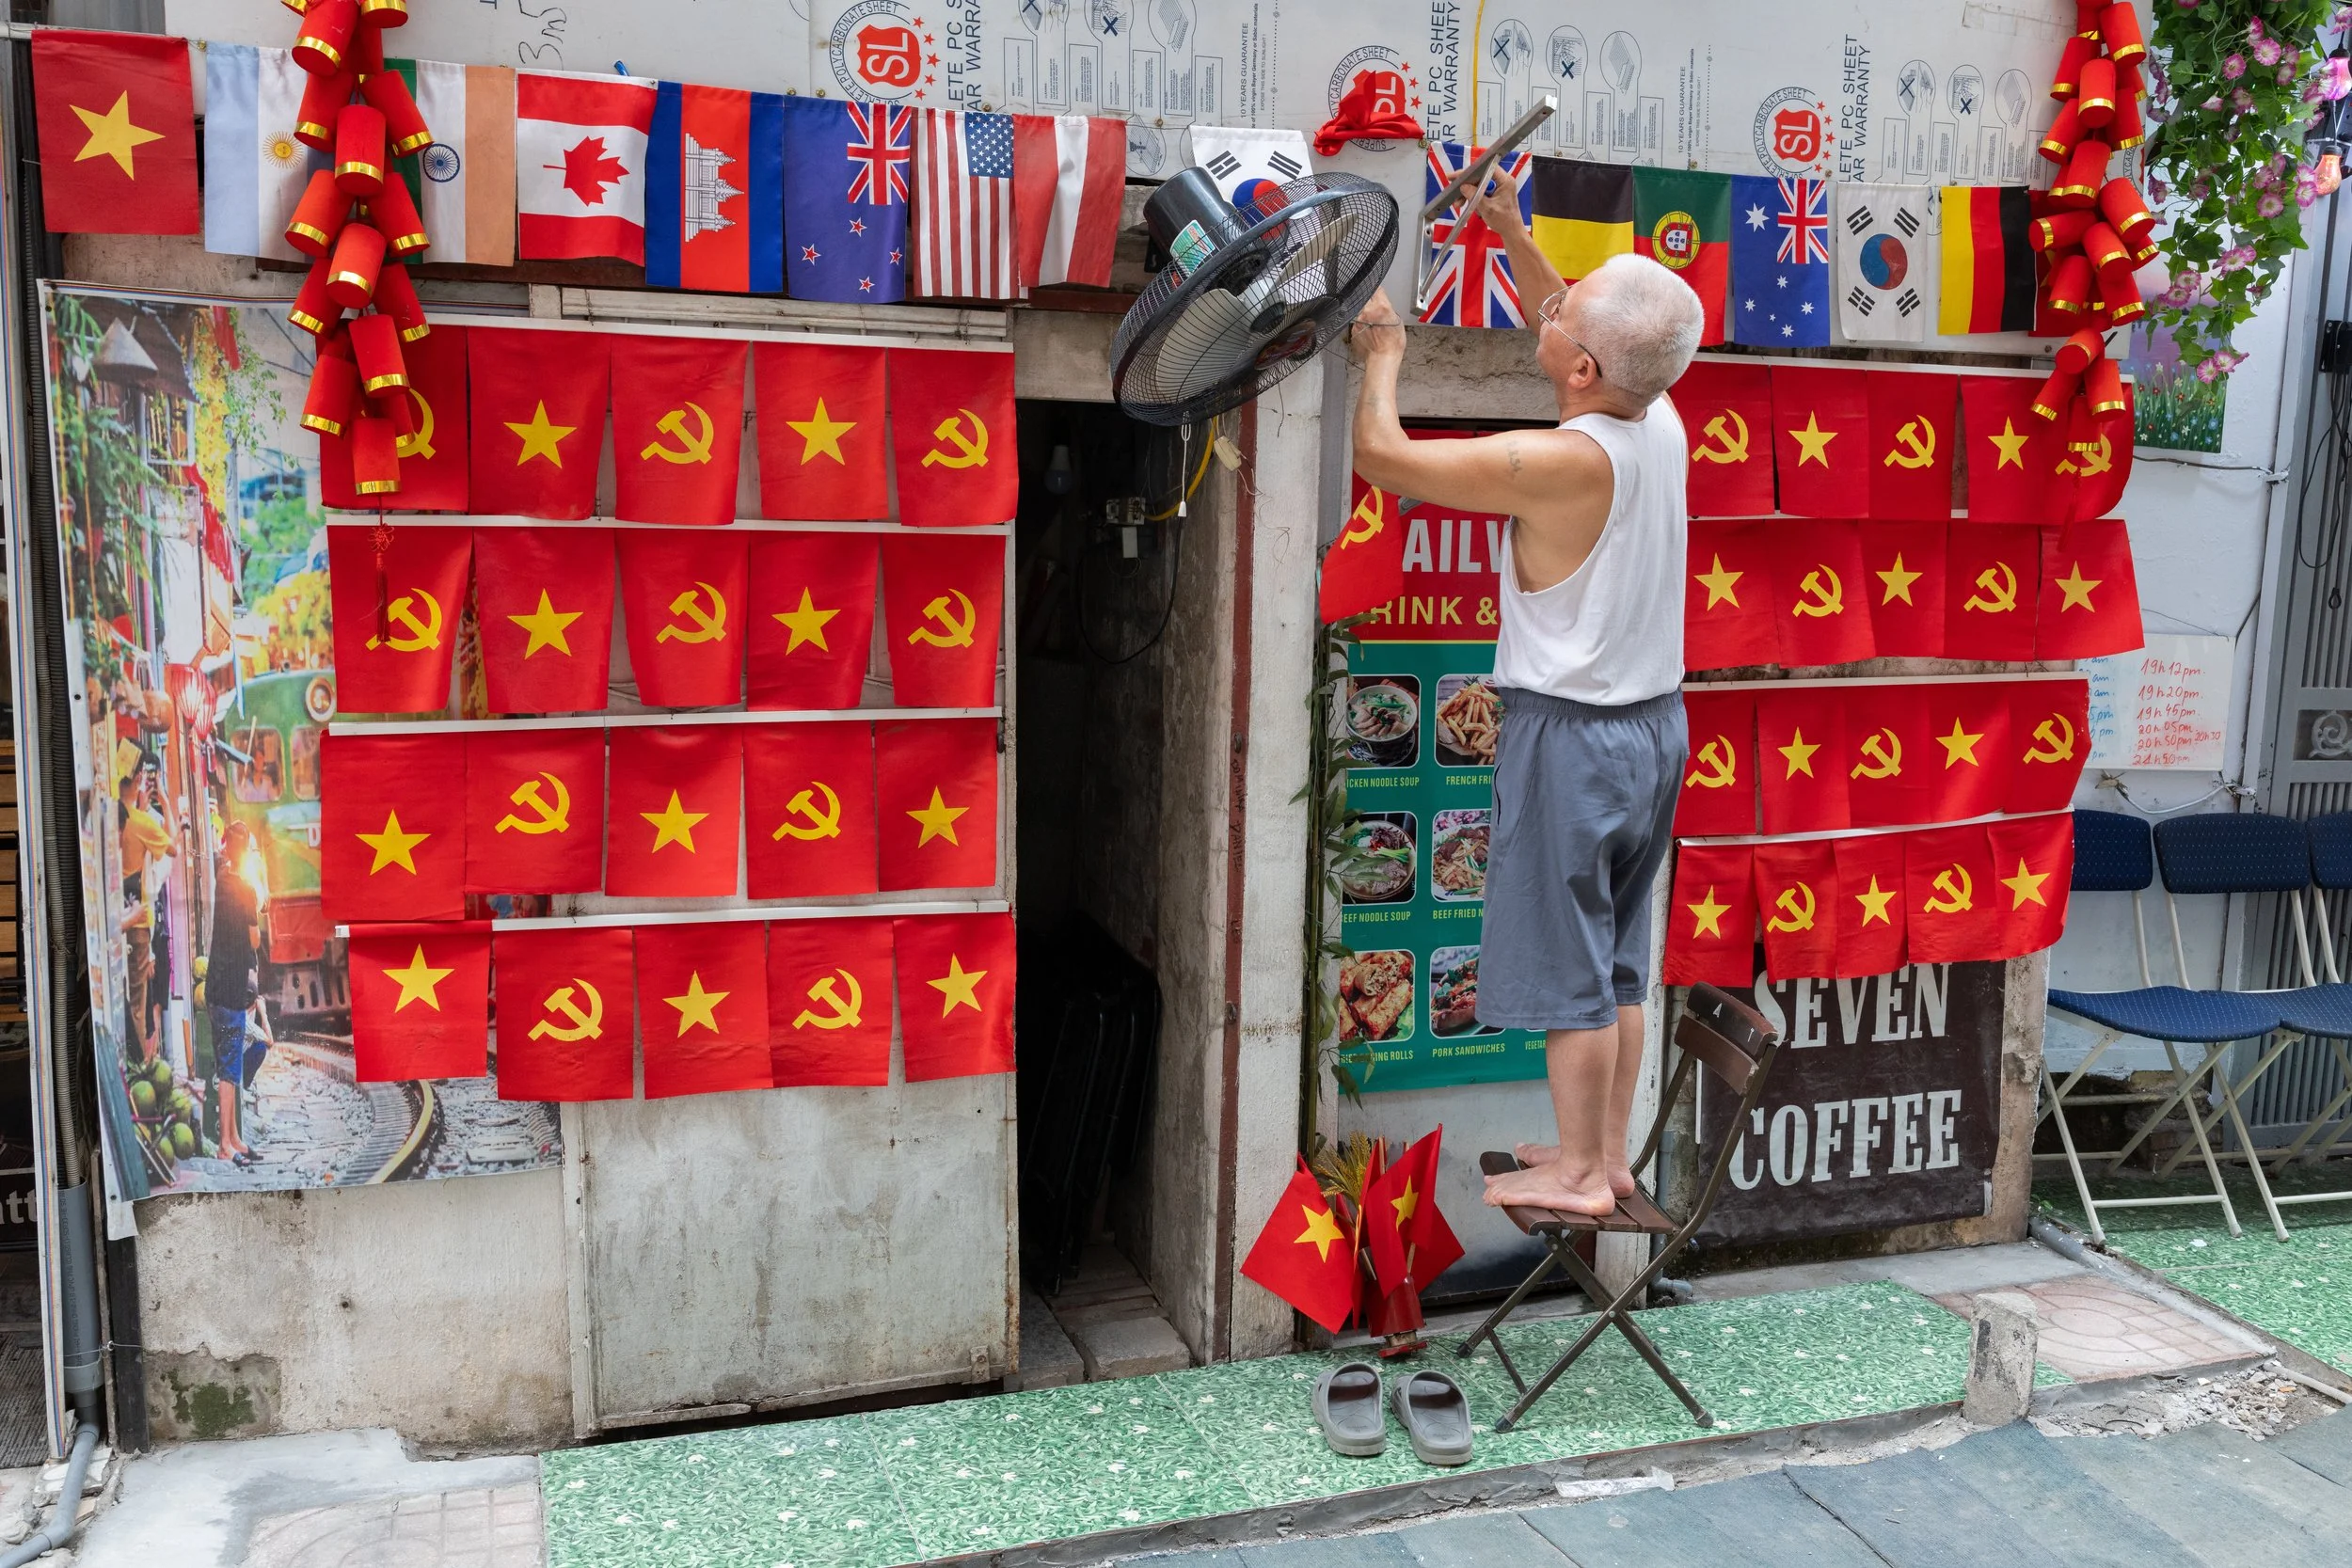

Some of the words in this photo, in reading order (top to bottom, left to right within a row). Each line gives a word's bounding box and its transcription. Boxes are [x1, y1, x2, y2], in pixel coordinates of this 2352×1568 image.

[832, 5, 866, 84] POLYCARBONATE
[866, 1, 898, 14] SHEET
[946, 22, 962, 50] PC
[1241, 23, 1249, 77] GUARANTEE
[866, 32, 910, 80] SL
[1362, 47, 1391, 59] SHEET
[1443, 1, 1460, 112] WARRANTY
[1842, 34, 1858, 94] SHEET
[1428, 66, 1443, 92] PC
[1678, 66, 1687, 116] GUARANTEE
[1854, 45, 1871, 147] WARRANTY
[1240, 108, 1248, 119] 10
[1755, 91, 1783, 159] POLYCARBONATE
[1783, 87, 1807, 99] SHEET
[1841, 104, 1854, 129] PC
[1678, 145, 1685, 153] 10
[1780, 114, 1813, 156] SL
[1475, 596, 1499, 626] &
[1370, 777, 1398, 787] NOODLE
[1400, 777, 1420, 787] SOUP
[1446, 775, 1477, 785] FRENCH
[1343, 912, 1358, 924] EEF
[1359, 911, 1389, 923] NOODLE
[1391, 911, 1411, 922] SOUP
[1433, 910, 1453, 919] BEEF
[1454, 909, 1476, 919] FRIED
[1755, 962, 1953, 1050] SEVEN
[1390, 1049, 1414, 1060] ROLLS
[1432, 1047, 1454, 1058] PORK
[1454, 1042, 1505, 1056] SANDWICHES
[1728, 1089, 1962, 1191] COFFEE
